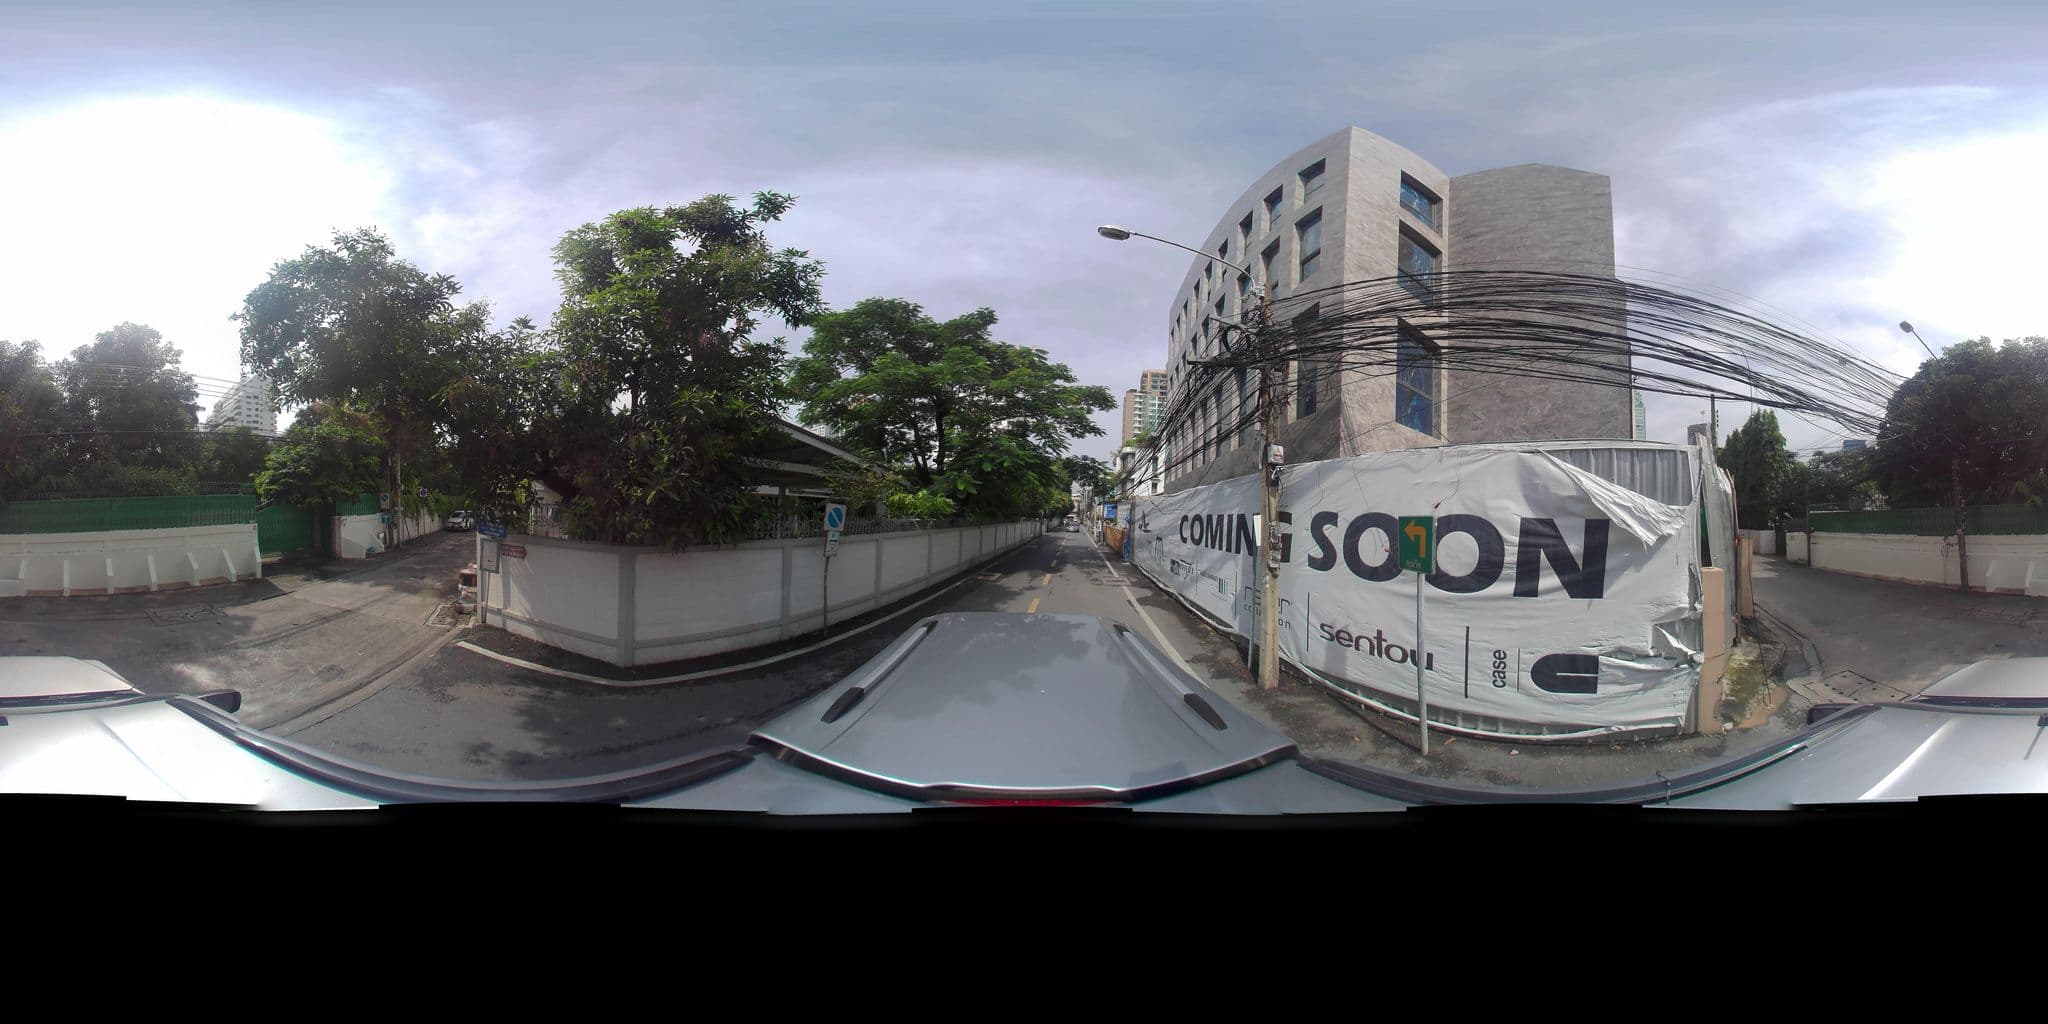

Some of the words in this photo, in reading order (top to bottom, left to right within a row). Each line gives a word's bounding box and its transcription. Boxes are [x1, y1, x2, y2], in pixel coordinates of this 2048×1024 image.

[1307, 511, 1610, 599] SOON
[1319, 621, 1434, 672] sentou
[1492, 649, 1507, 689] case
